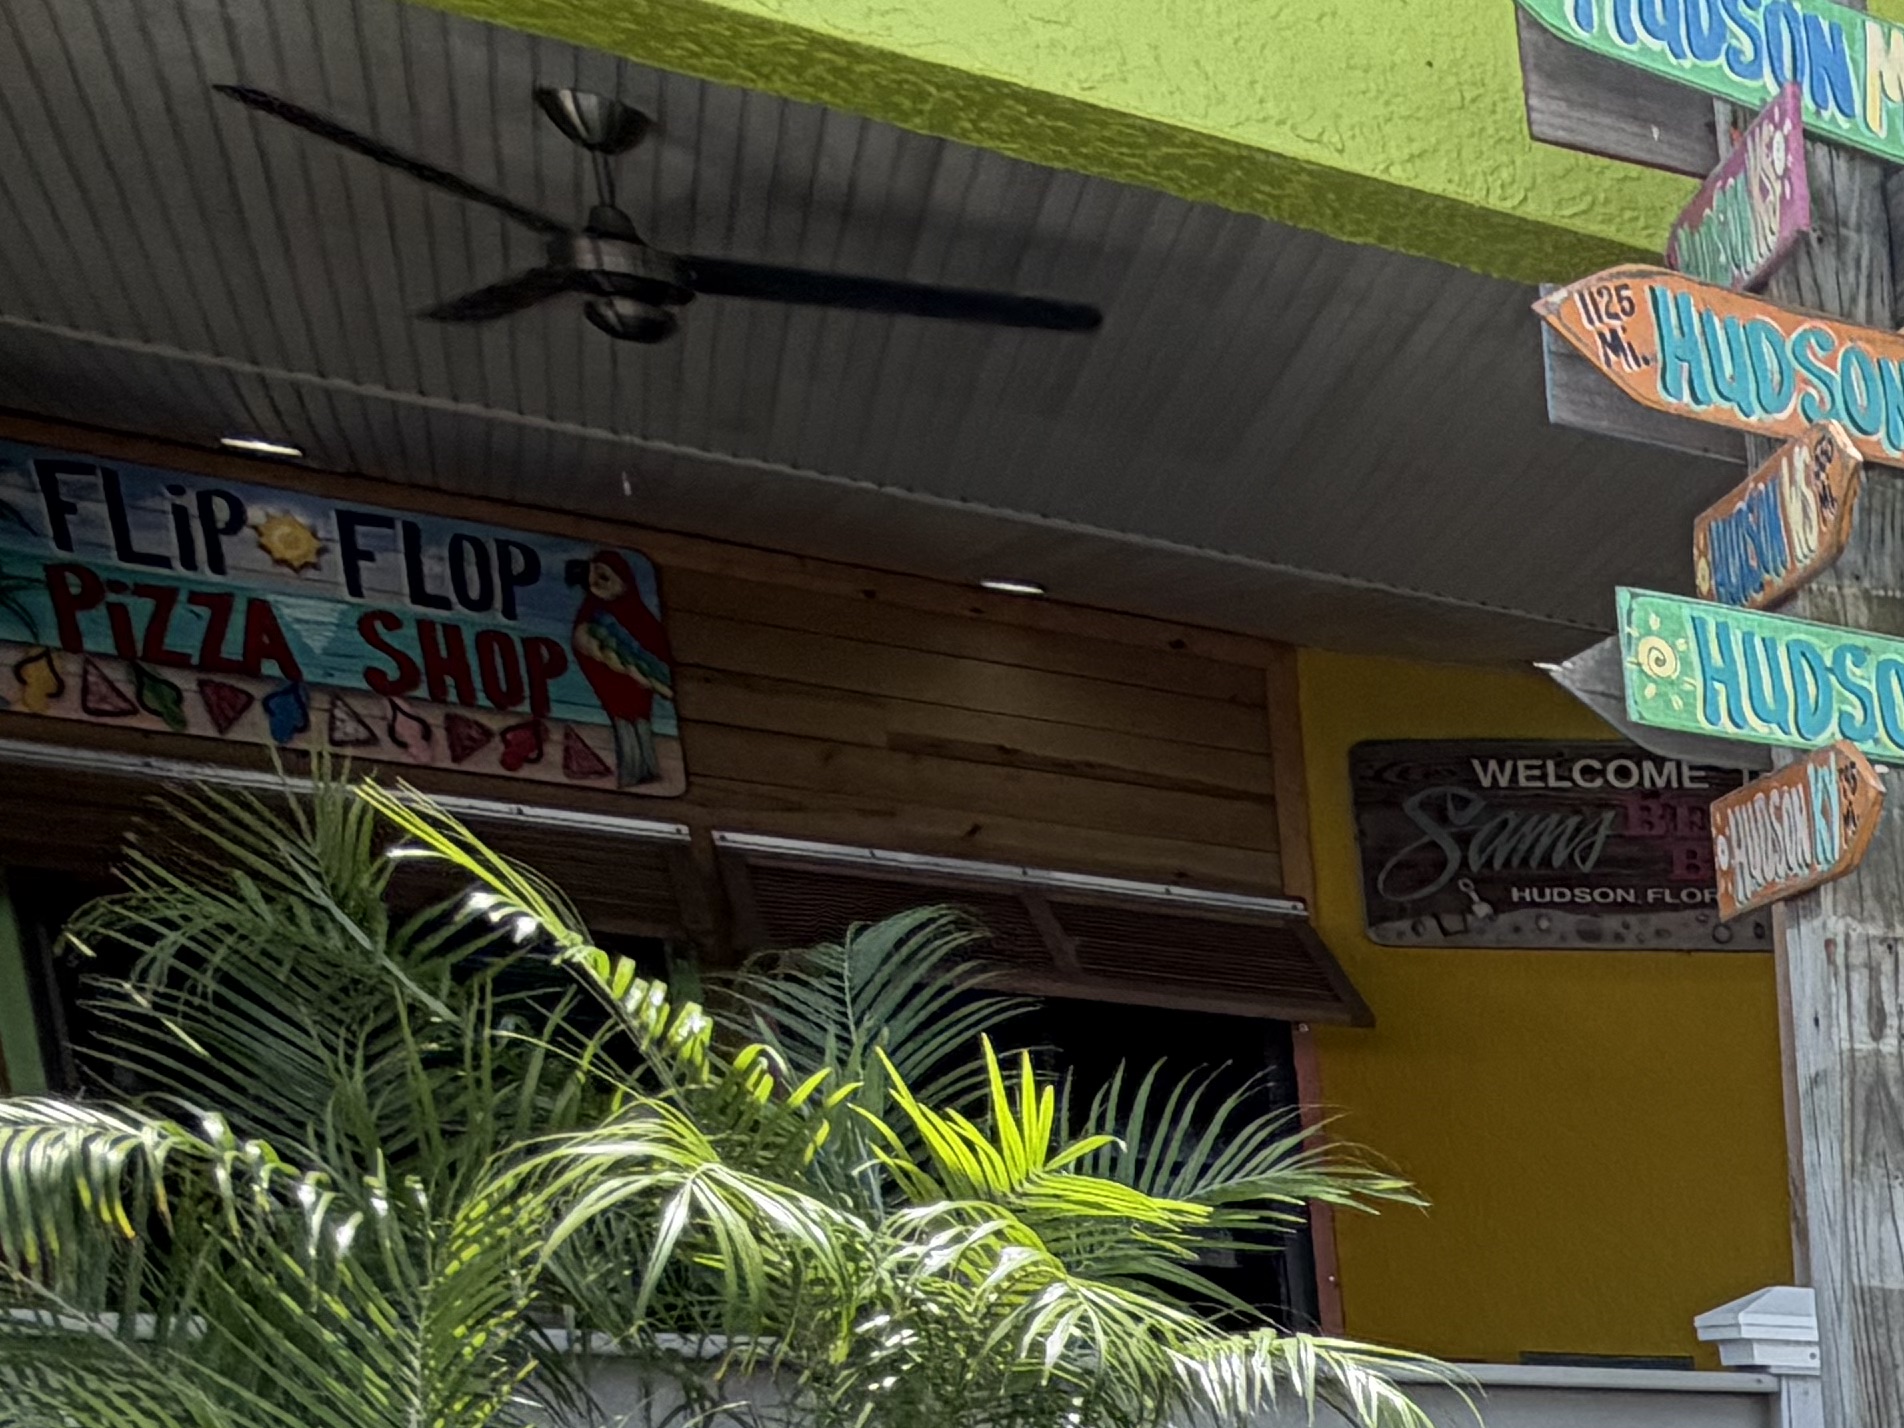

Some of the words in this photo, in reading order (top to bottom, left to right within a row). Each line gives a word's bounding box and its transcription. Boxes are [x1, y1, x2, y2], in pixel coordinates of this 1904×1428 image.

[333, 508, 543, 621] FLOP
[356, 610, 570, 719] SHOP
[1470, 758, 1711, 791] WELCOME
[1728, 784, 1814, 908] HUDSON
